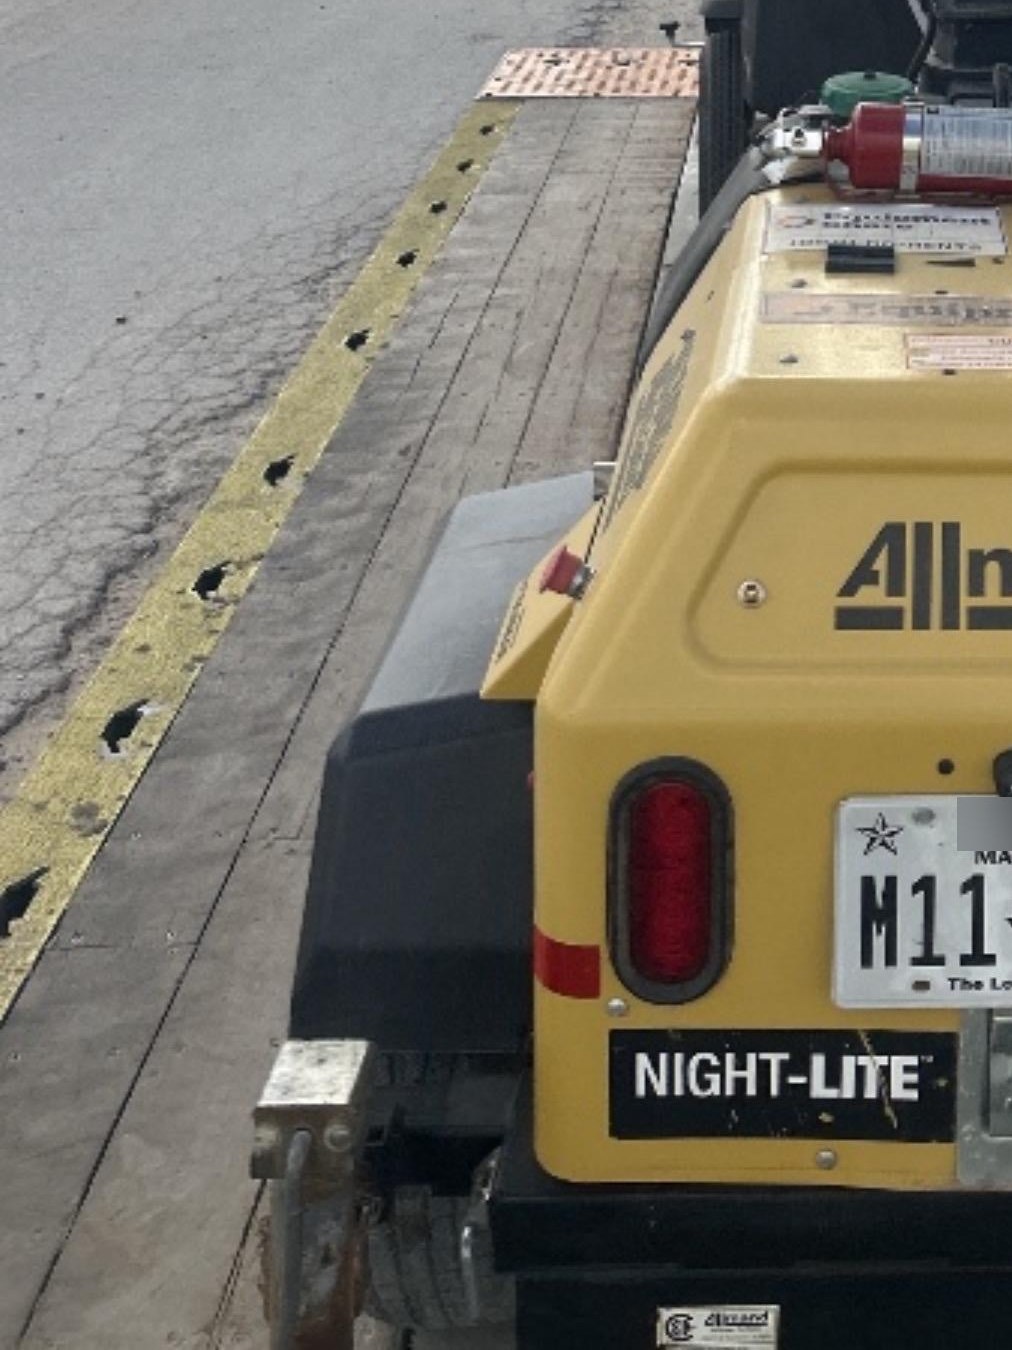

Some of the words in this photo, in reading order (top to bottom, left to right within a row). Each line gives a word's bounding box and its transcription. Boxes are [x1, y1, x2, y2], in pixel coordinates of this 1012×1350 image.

[859, 872, 997, 970] M11
[948, 977, 984, 992] The
[634, 1052, 919, 1100] NIGHT-LITE
